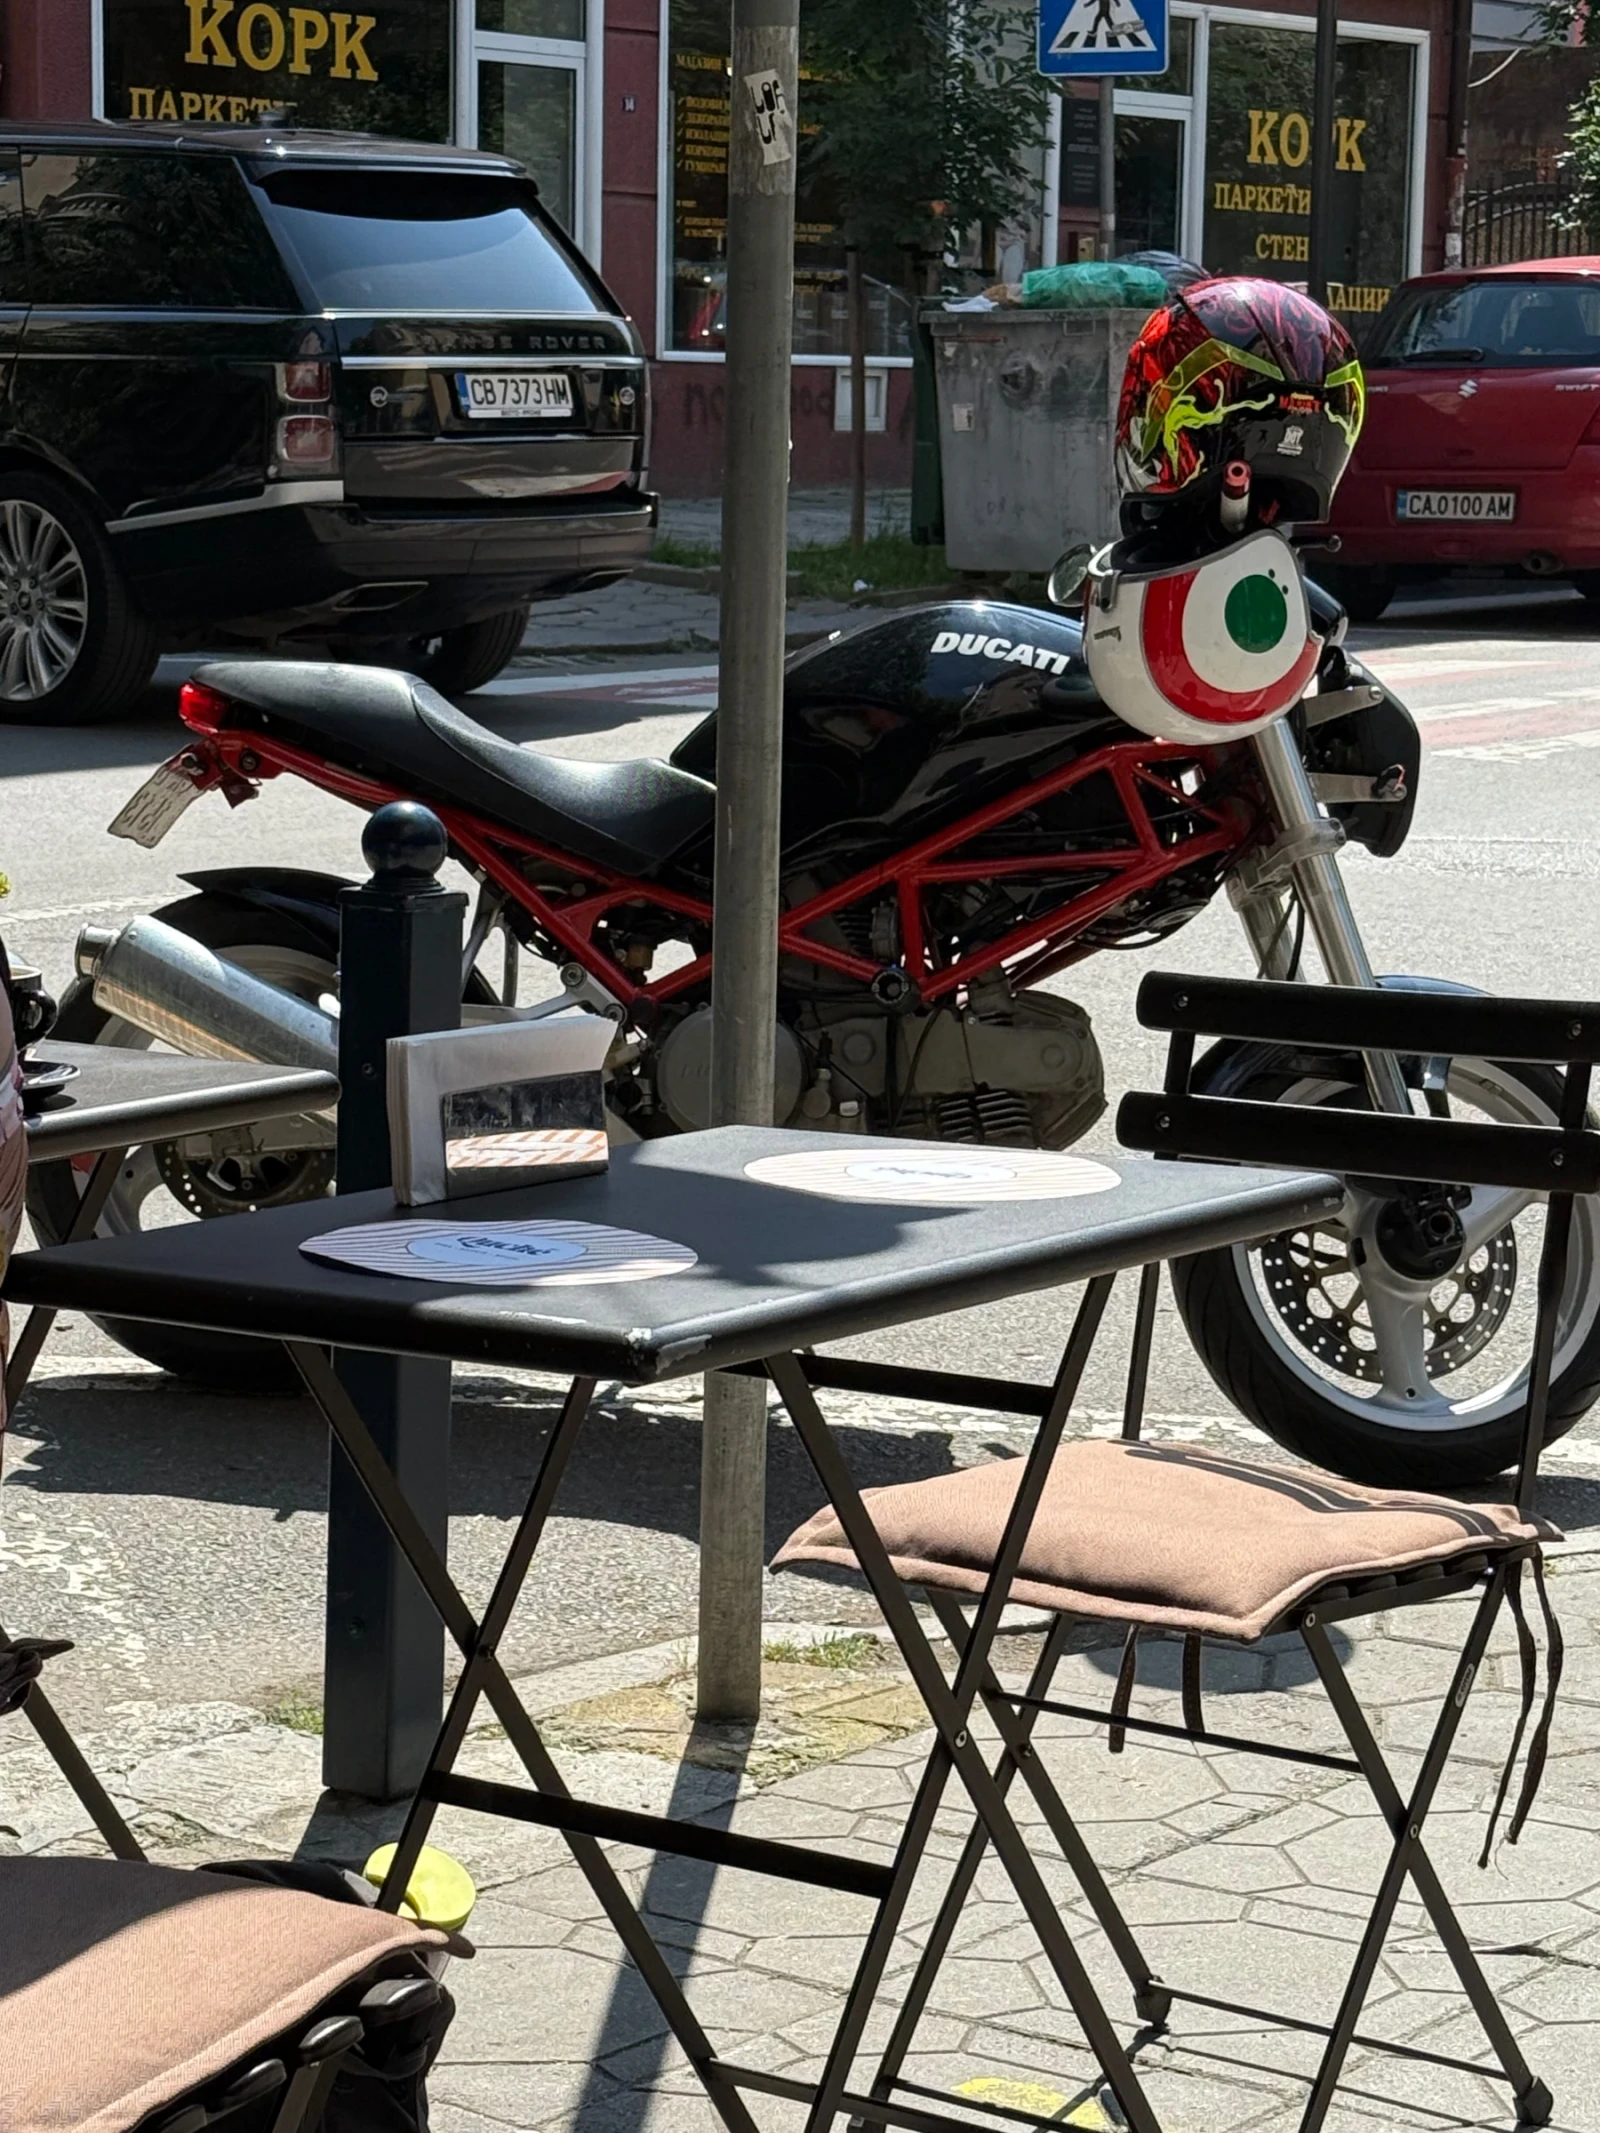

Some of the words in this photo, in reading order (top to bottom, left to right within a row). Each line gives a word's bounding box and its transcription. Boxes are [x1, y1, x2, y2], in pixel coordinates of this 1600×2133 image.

[184, 0, 379, 81] КОРК
[1247, 110, 1366, 172] КОК
[1214, 183, 1311, 215] ПАРКЕТИ
[1256, 233, 1310, 262] СТЕН
[529, 336, 607, 350] ROVER
[931, 632, 1071, 675] DUCATI
